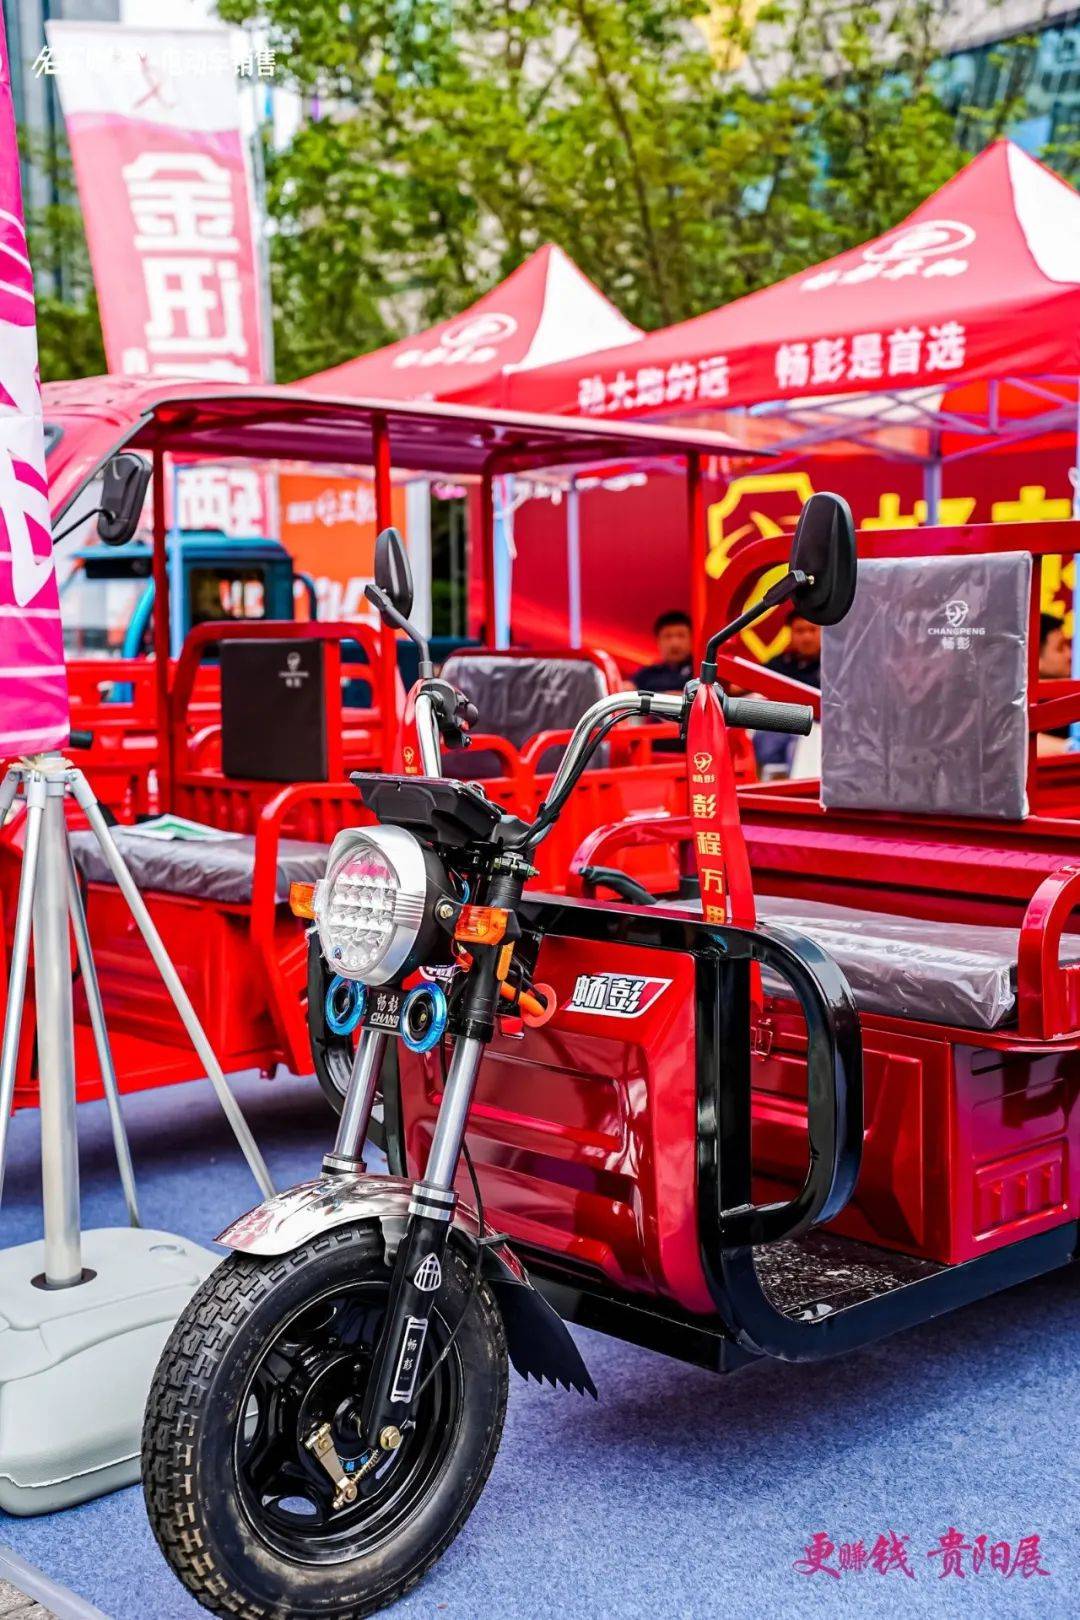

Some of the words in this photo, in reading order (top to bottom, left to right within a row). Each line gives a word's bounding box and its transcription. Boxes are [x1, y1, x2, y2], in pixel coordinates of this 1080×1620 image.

[775, 320, 967, 389] 畅彭是首选
[927, 627, 986, 636] CHANGPENG
[572, 974, 644, 1013] 畅彭
